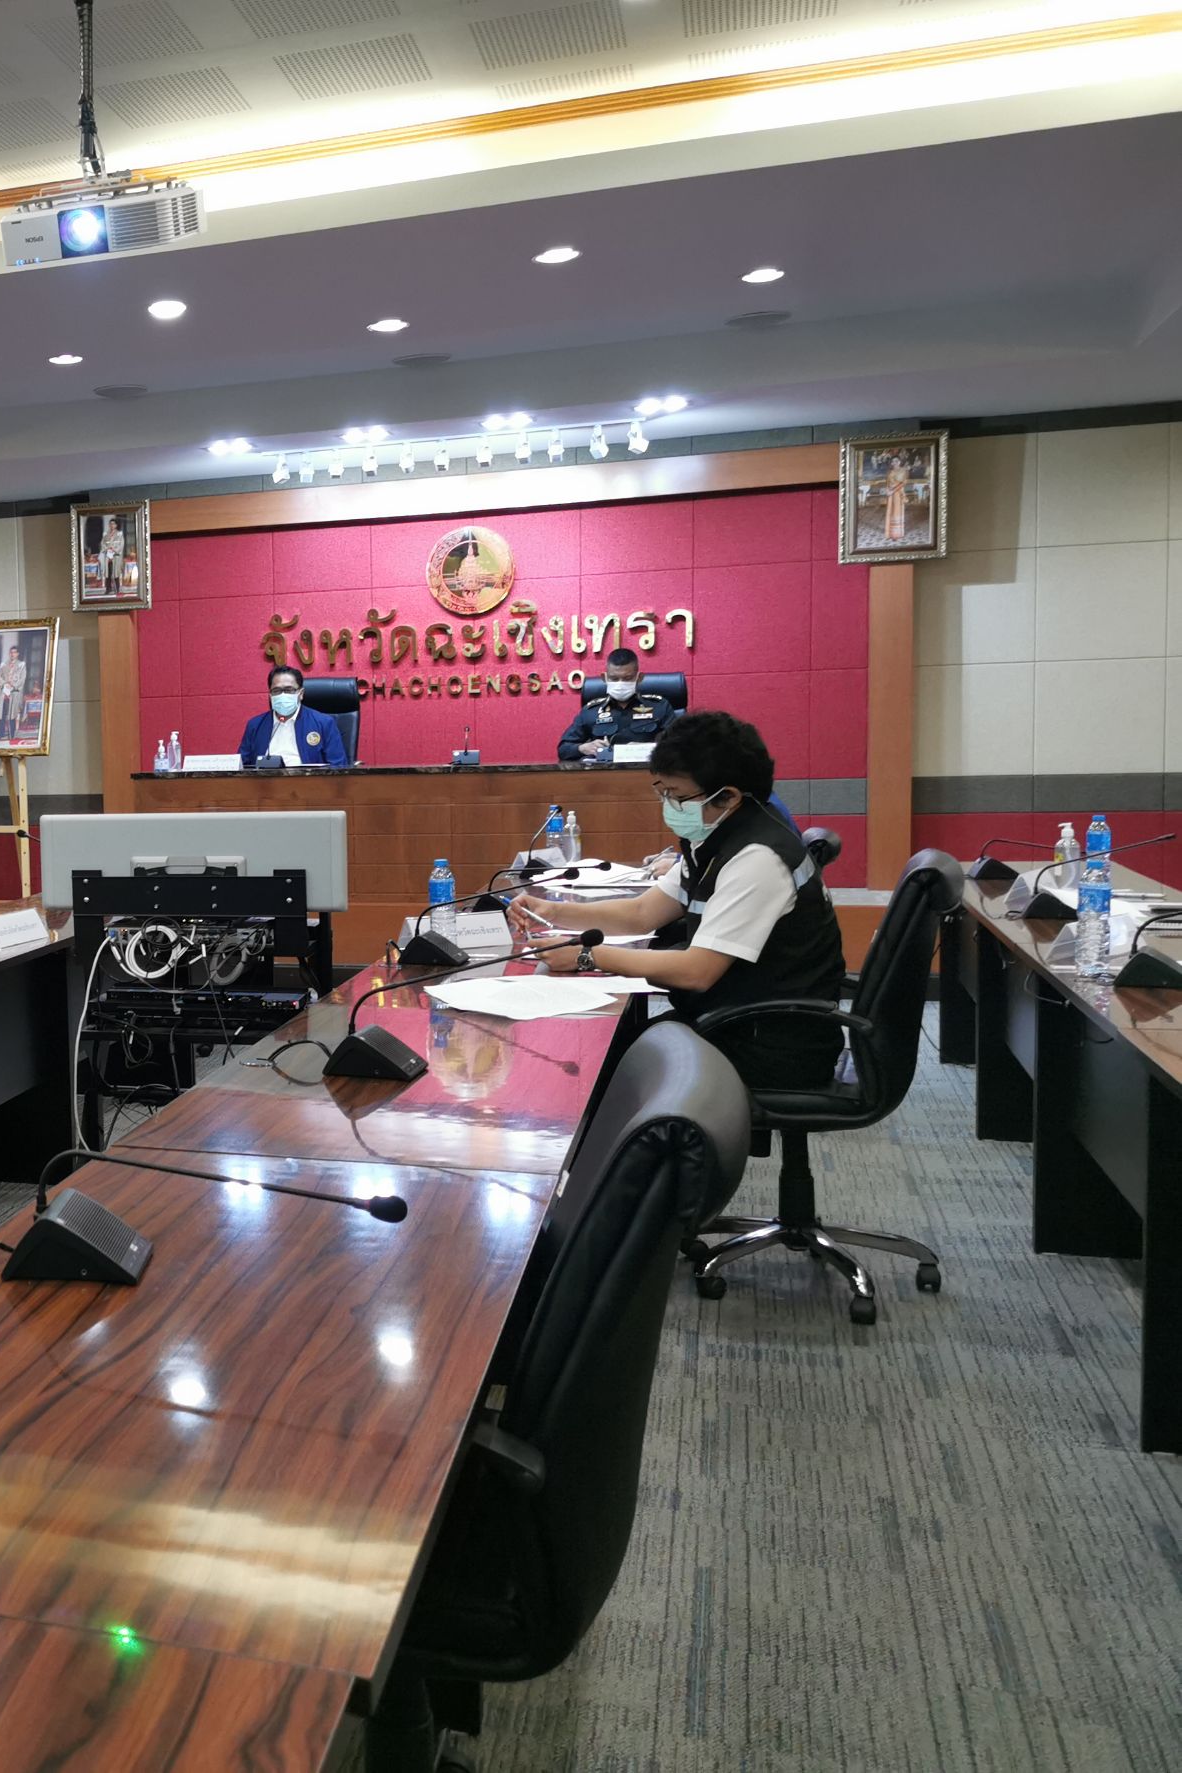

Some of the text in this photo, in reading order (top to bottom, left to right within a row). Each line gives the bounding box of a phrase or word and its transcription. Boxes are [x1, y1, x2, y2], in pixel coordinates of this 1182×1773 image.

[260, 599, 694, 668] จังหวัดฉะเชิงเทรา
[358, 669, 586, 698] CHACHOENGSAO
